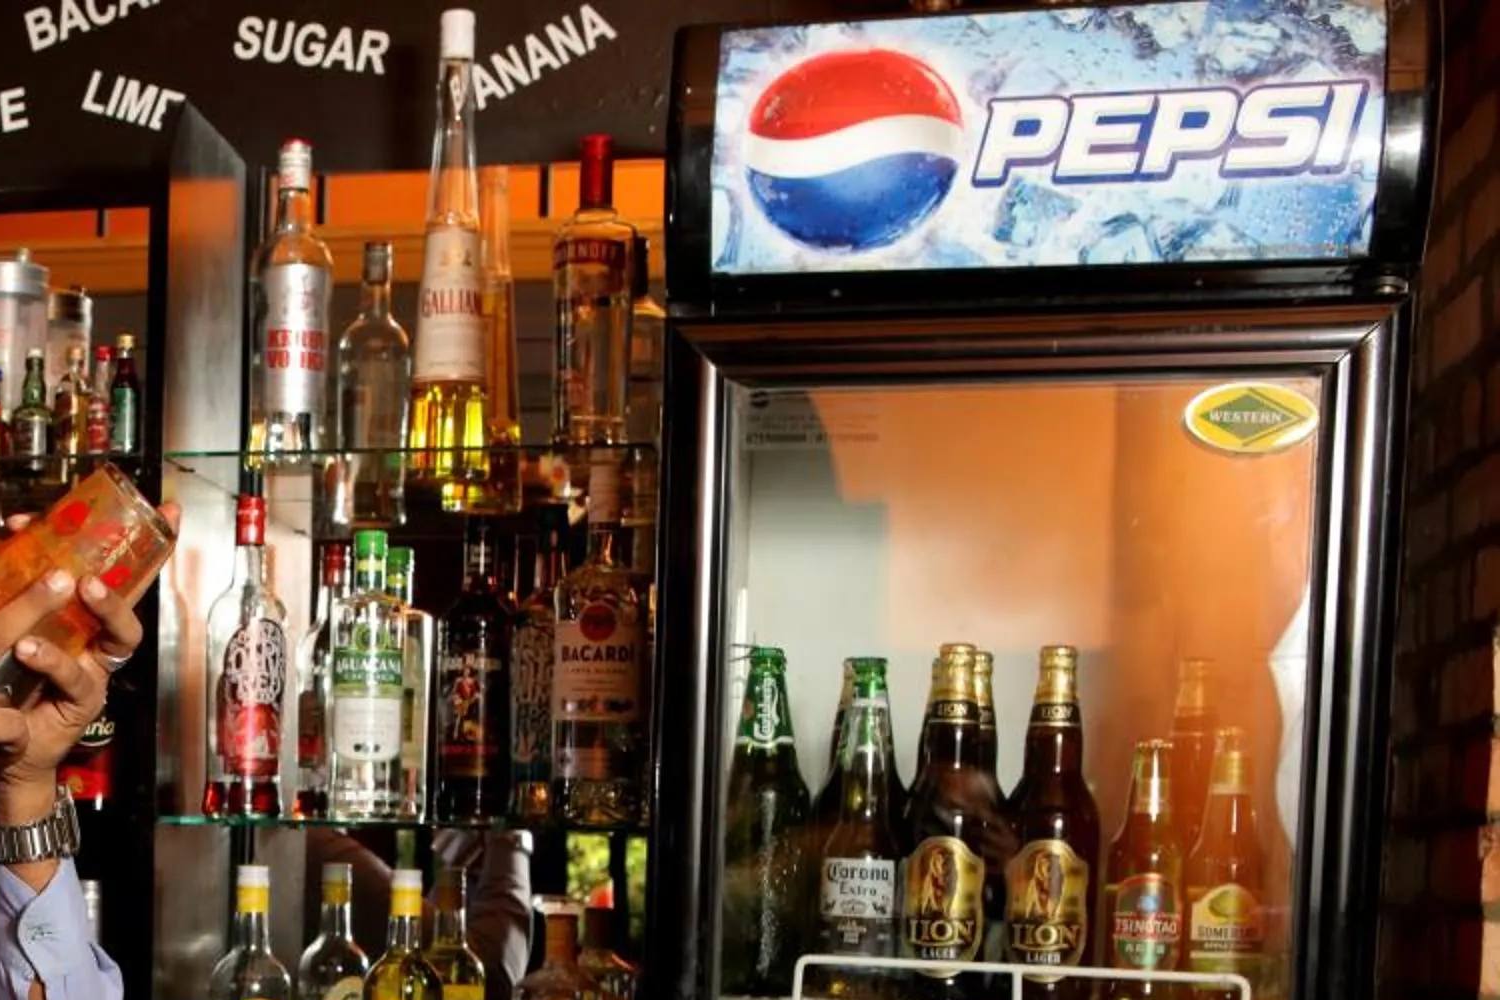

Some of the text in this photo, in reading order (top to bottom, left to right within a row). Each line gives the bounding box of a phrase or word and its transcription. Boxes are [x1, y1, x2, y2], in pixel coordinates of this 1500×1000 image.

[24, 0, 160, 52] BAC
[233, 16, 390, 75] SUGAR
[972, 80, 1370, 188] PEPSI
[1208, 409, 1283, 425] WESTERN
[827, 862, 890, 884] Corona
[909, 918, 975, 948] LION
[1011, 923, 1080, 952] LION
